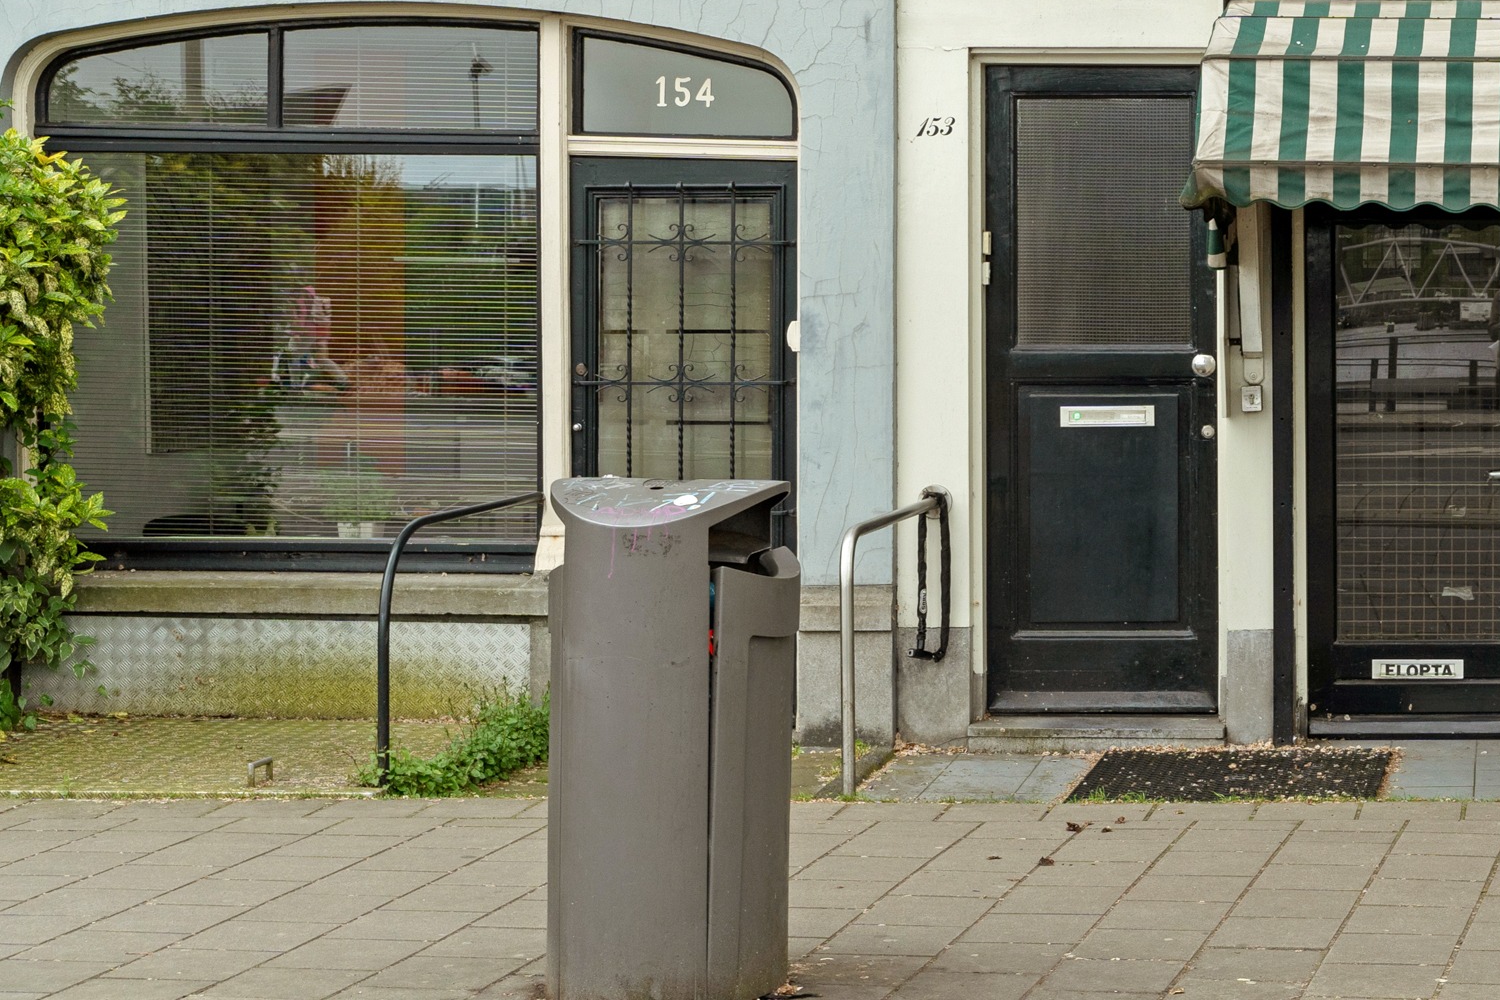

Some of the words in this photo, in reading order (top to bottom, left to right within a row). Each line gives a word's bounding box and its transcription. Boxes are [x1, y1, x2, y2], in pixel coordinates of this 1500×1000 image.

[655, 75, 715, 108] 154
[916, 116, 956, 137] 153
[1385, 663, 1453, 676] ELOPTA
